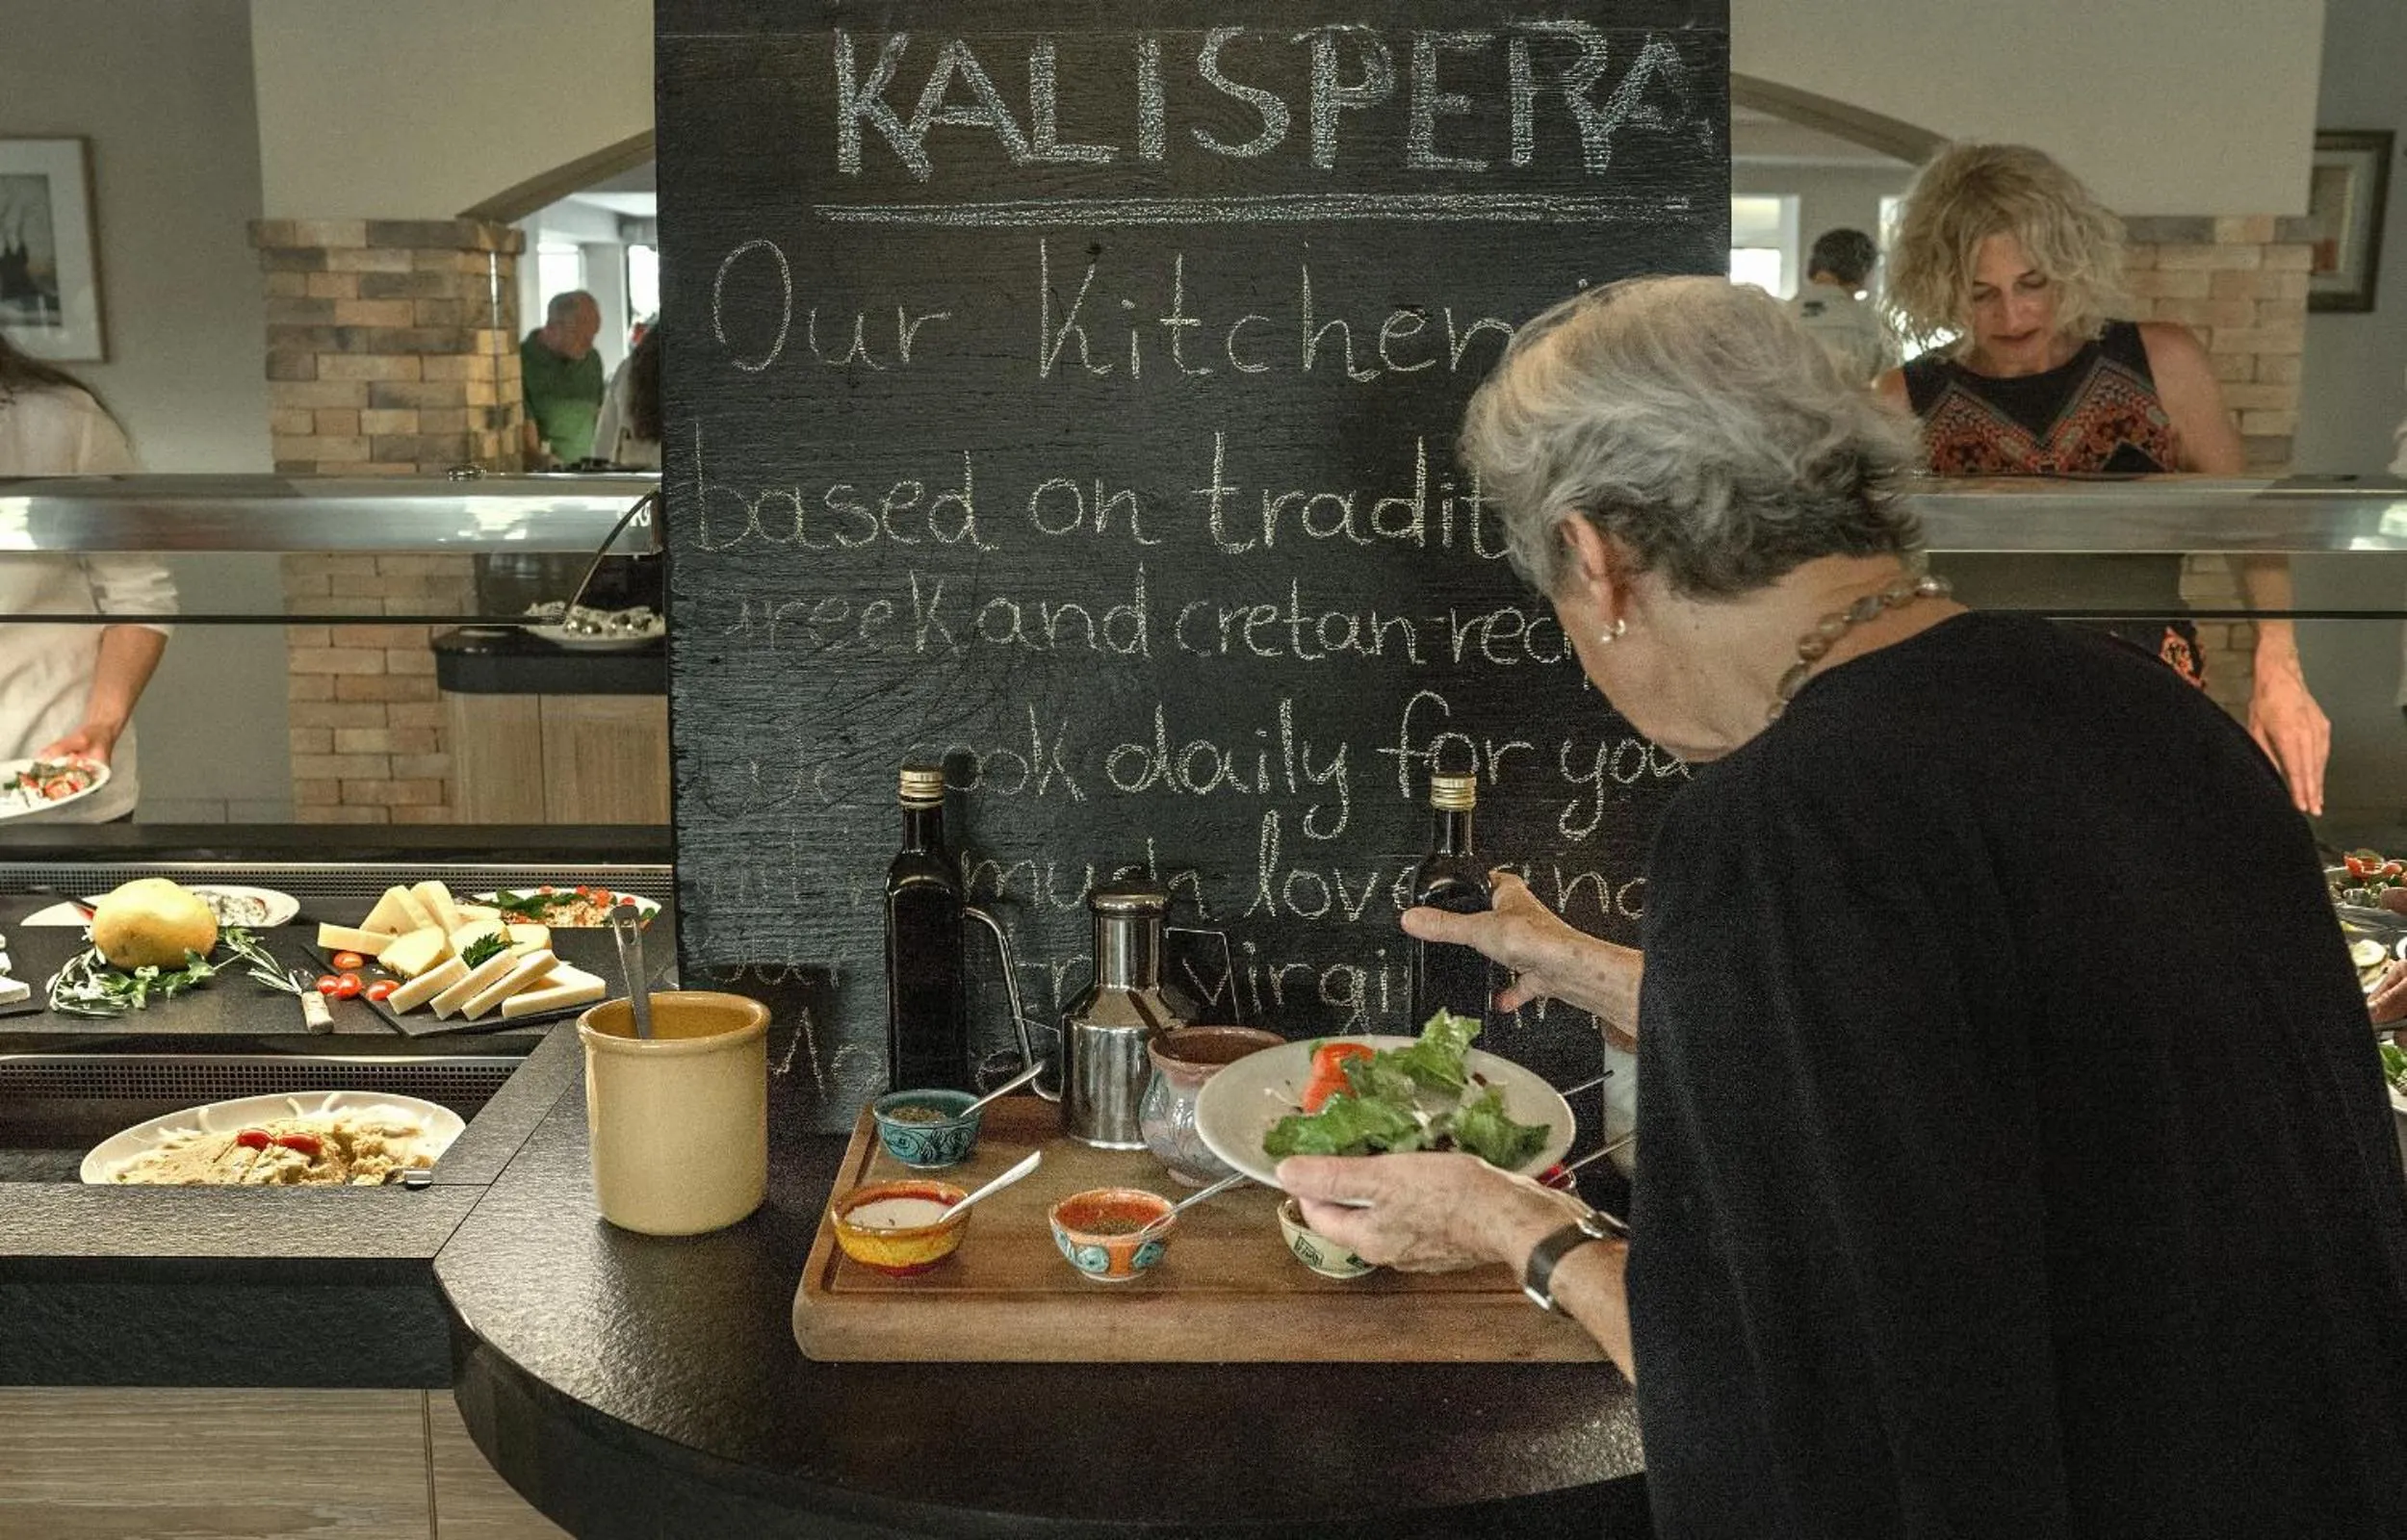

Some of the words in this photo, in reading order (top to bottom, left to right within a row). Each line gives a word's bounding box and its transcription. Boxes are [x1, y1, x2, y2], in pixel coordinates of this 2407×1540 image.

[834, 21, 1718, 183] KALISPERA
[713, 239, 952, 372] Our
[690, 423, 999, 552] based
[1029, 478, 1162, 546] on
[1191, 431, 1512, 559] tradit
[976, 561, 1152, 658] and
[1175, 578, 1426, 661] cretan
[905, 703, 1086, 805] ook
[1106, 699, 1350, 840] daily
[1376, 691, 1535, 799] for
